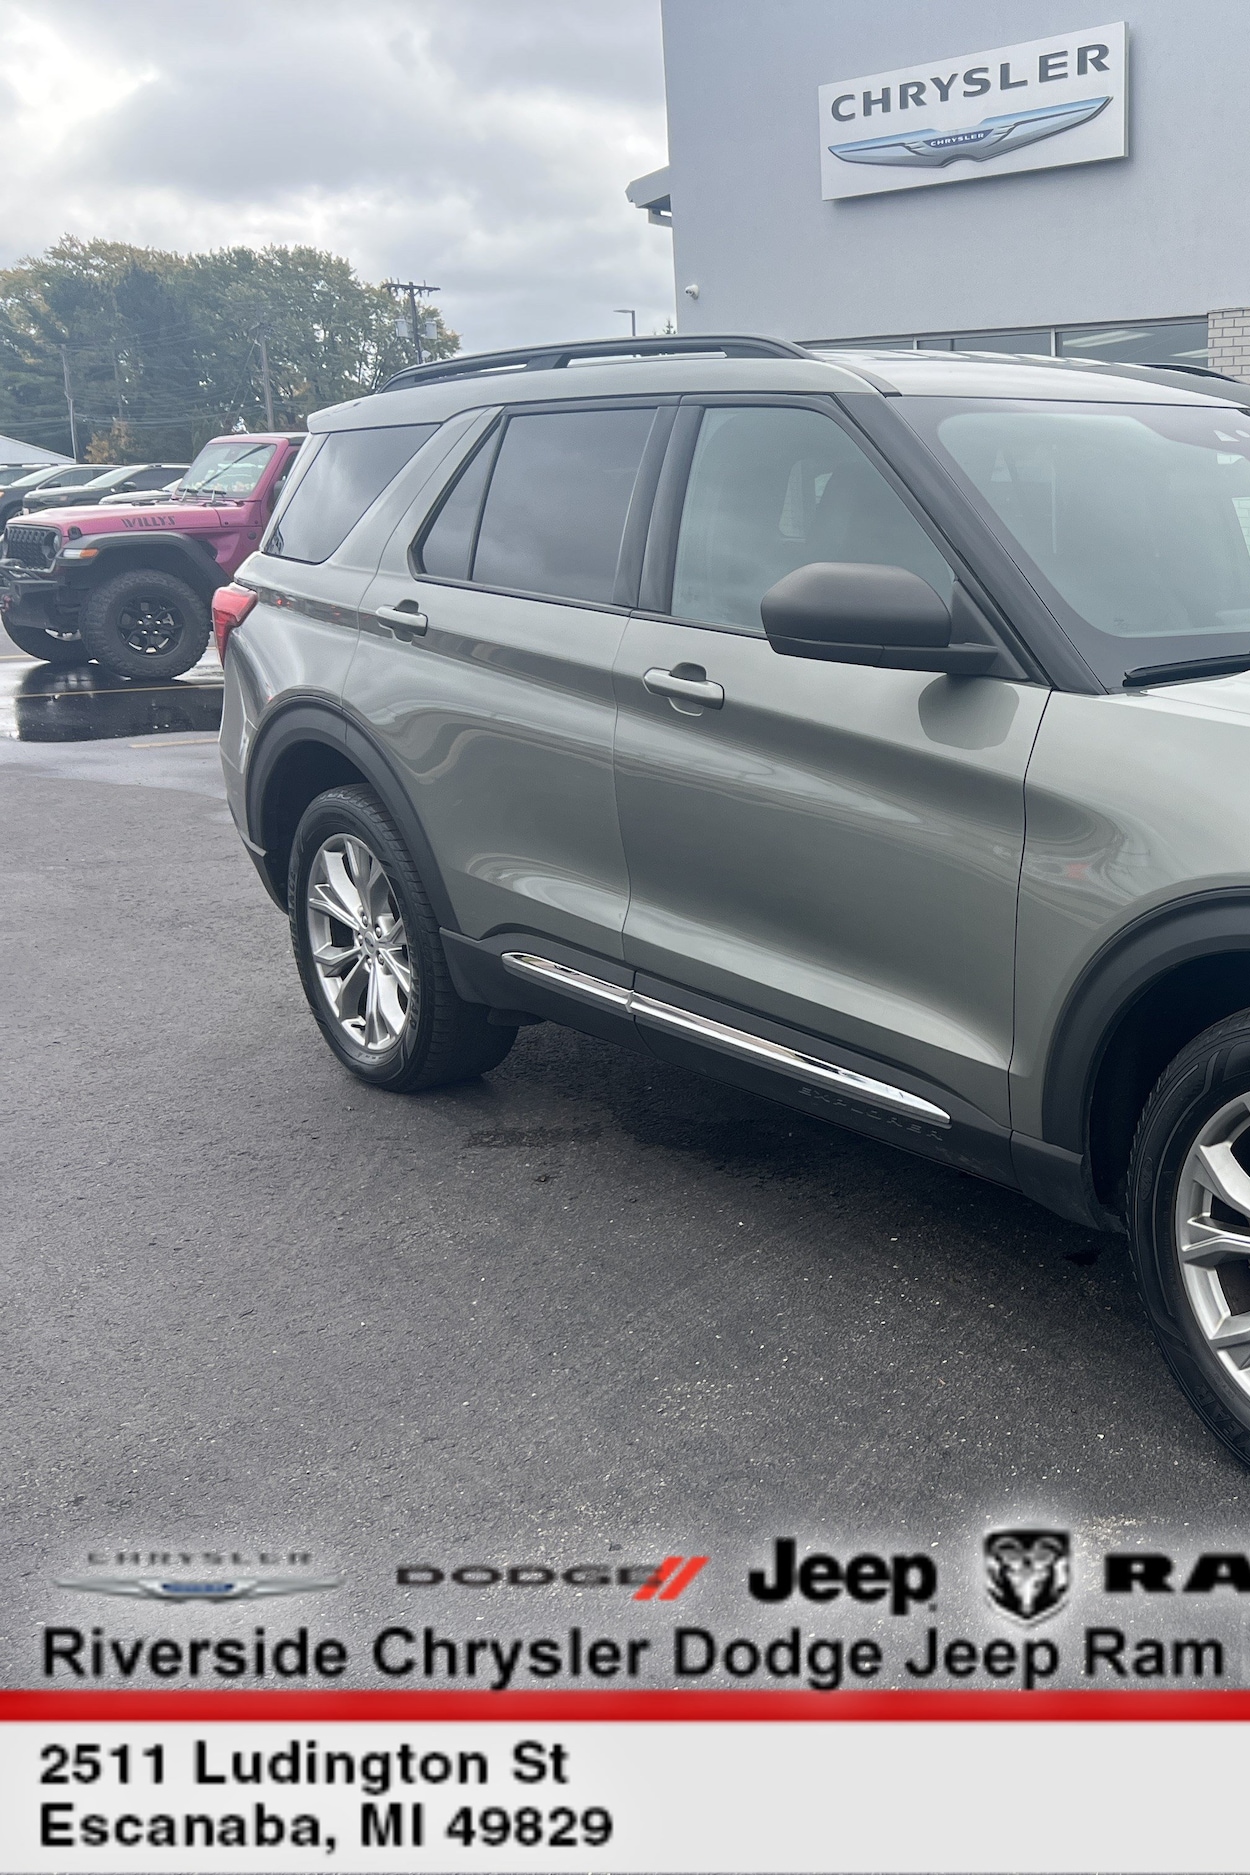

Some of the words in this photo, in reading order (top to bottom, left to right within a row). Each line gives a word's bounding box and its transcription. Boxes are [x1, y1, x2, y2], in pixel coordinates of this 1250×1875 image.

[830, 43, 1111, 122] CHRYSLER
[930, 133, 984, 147] CHRYSLER
[120, 516, 176, 528] WILLYS
